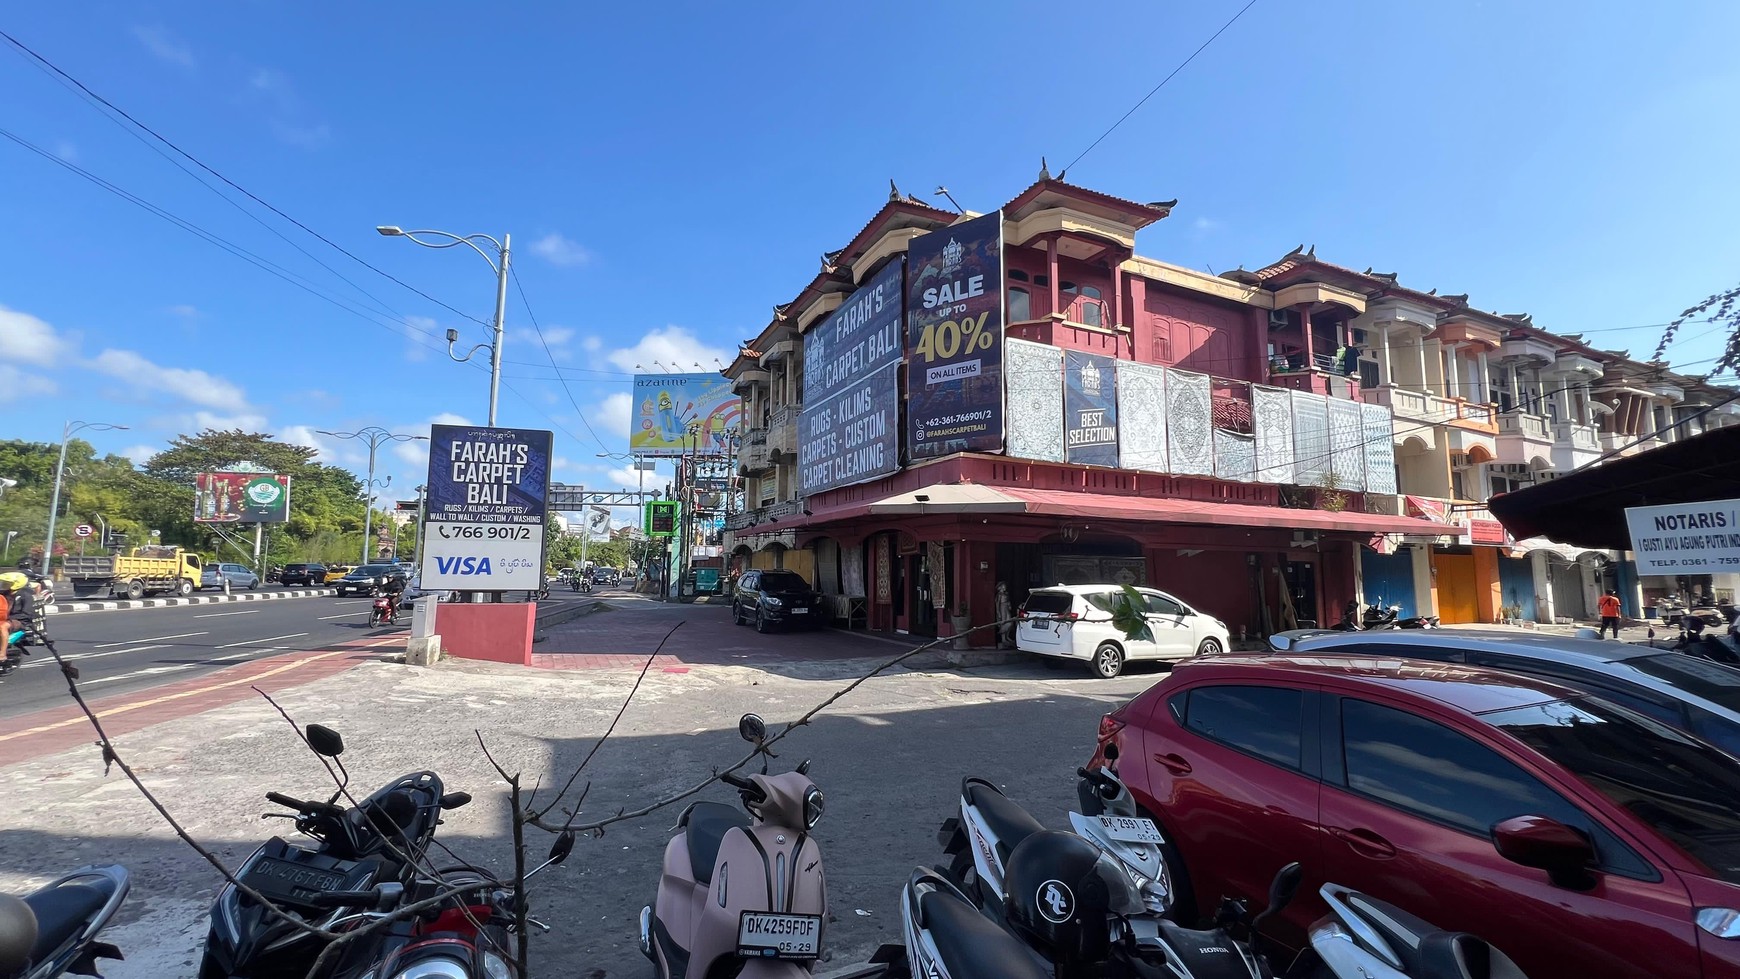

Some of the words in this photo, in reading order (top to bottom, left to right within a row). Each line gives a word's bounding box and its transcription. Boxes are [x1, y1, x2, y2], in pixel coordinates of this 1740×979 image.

[922, 274, 984, 309] SALE
[836, 284, 883, 343] FARAH'S
[939, 308, 952, 317] UP
[953, 303, 967, 314] TO
[915, 311, 993, 363] 40%
[826, 341, 865, 389] CARPET
[868, 319, 898, 363] BALI
[930, 371, 942, 380] ON
[942, 368, 955, 377] ALL
[956, 364, 977, 375] ITEMS
[810, 408, 831, 437] RUGS
[839, 386, 871, 424] KILIMS
[925, 410, 992, 427] +62-361-766901/2
[1081, 412, 1103, 428] BEST
[802, 432, 837, 465] CARPETS
[845, 409, 886, 449] CUSTOM
[926, 424, 987, 437] @FARAHSCARPETBALI
[1069, 427, 1115, 445] SELECTION
[451, 441, 529, 464] FARAH'S
[453, 461, 525, 484] CARPET
[803, 460, 833, 489] CARPET
[835, 442, 884, 480] CLEANING
[467, 483, 508, 505] BALI
[430, 513, 447, 521] WALL
[448, 513, 457, 521] TO
[458, 513, 474, 521] WALL
[481, 514, 506, 522] CUSTOM
[513, 515, 541, 523] WASHING
[444, 504, 462, 512] RUGS
[468, 505, 489, 513] KILIMS
[495, 506, 523, 514] CARPETS
[1653, 511, 1727, 531] NOTARIS
[452, 526, 483, 539] 766
[487, 525, 530, 540] 901/2
[1638, 538, 1643, 552] I
[1642, 536, 1664, 552] GUSTI
[1664, 536, 1678, 551] AYU
[1679, 535, 1705, 550] AGUNG
[1705, 534, 1729, 549] PUTRI
[432, 556, 492, 576] VISA
[1649, 559, 1679, 567] TELP.
[1681, 558, 1708, 566] 0361
[1718, 557, 1740, 565] 759
[1117, 818, 1141, 830] 2991
[256, 861, 275, 876] DK
[278, 867, 315, 886] 4767
[1199, 946, 1230, 954] HONDA
